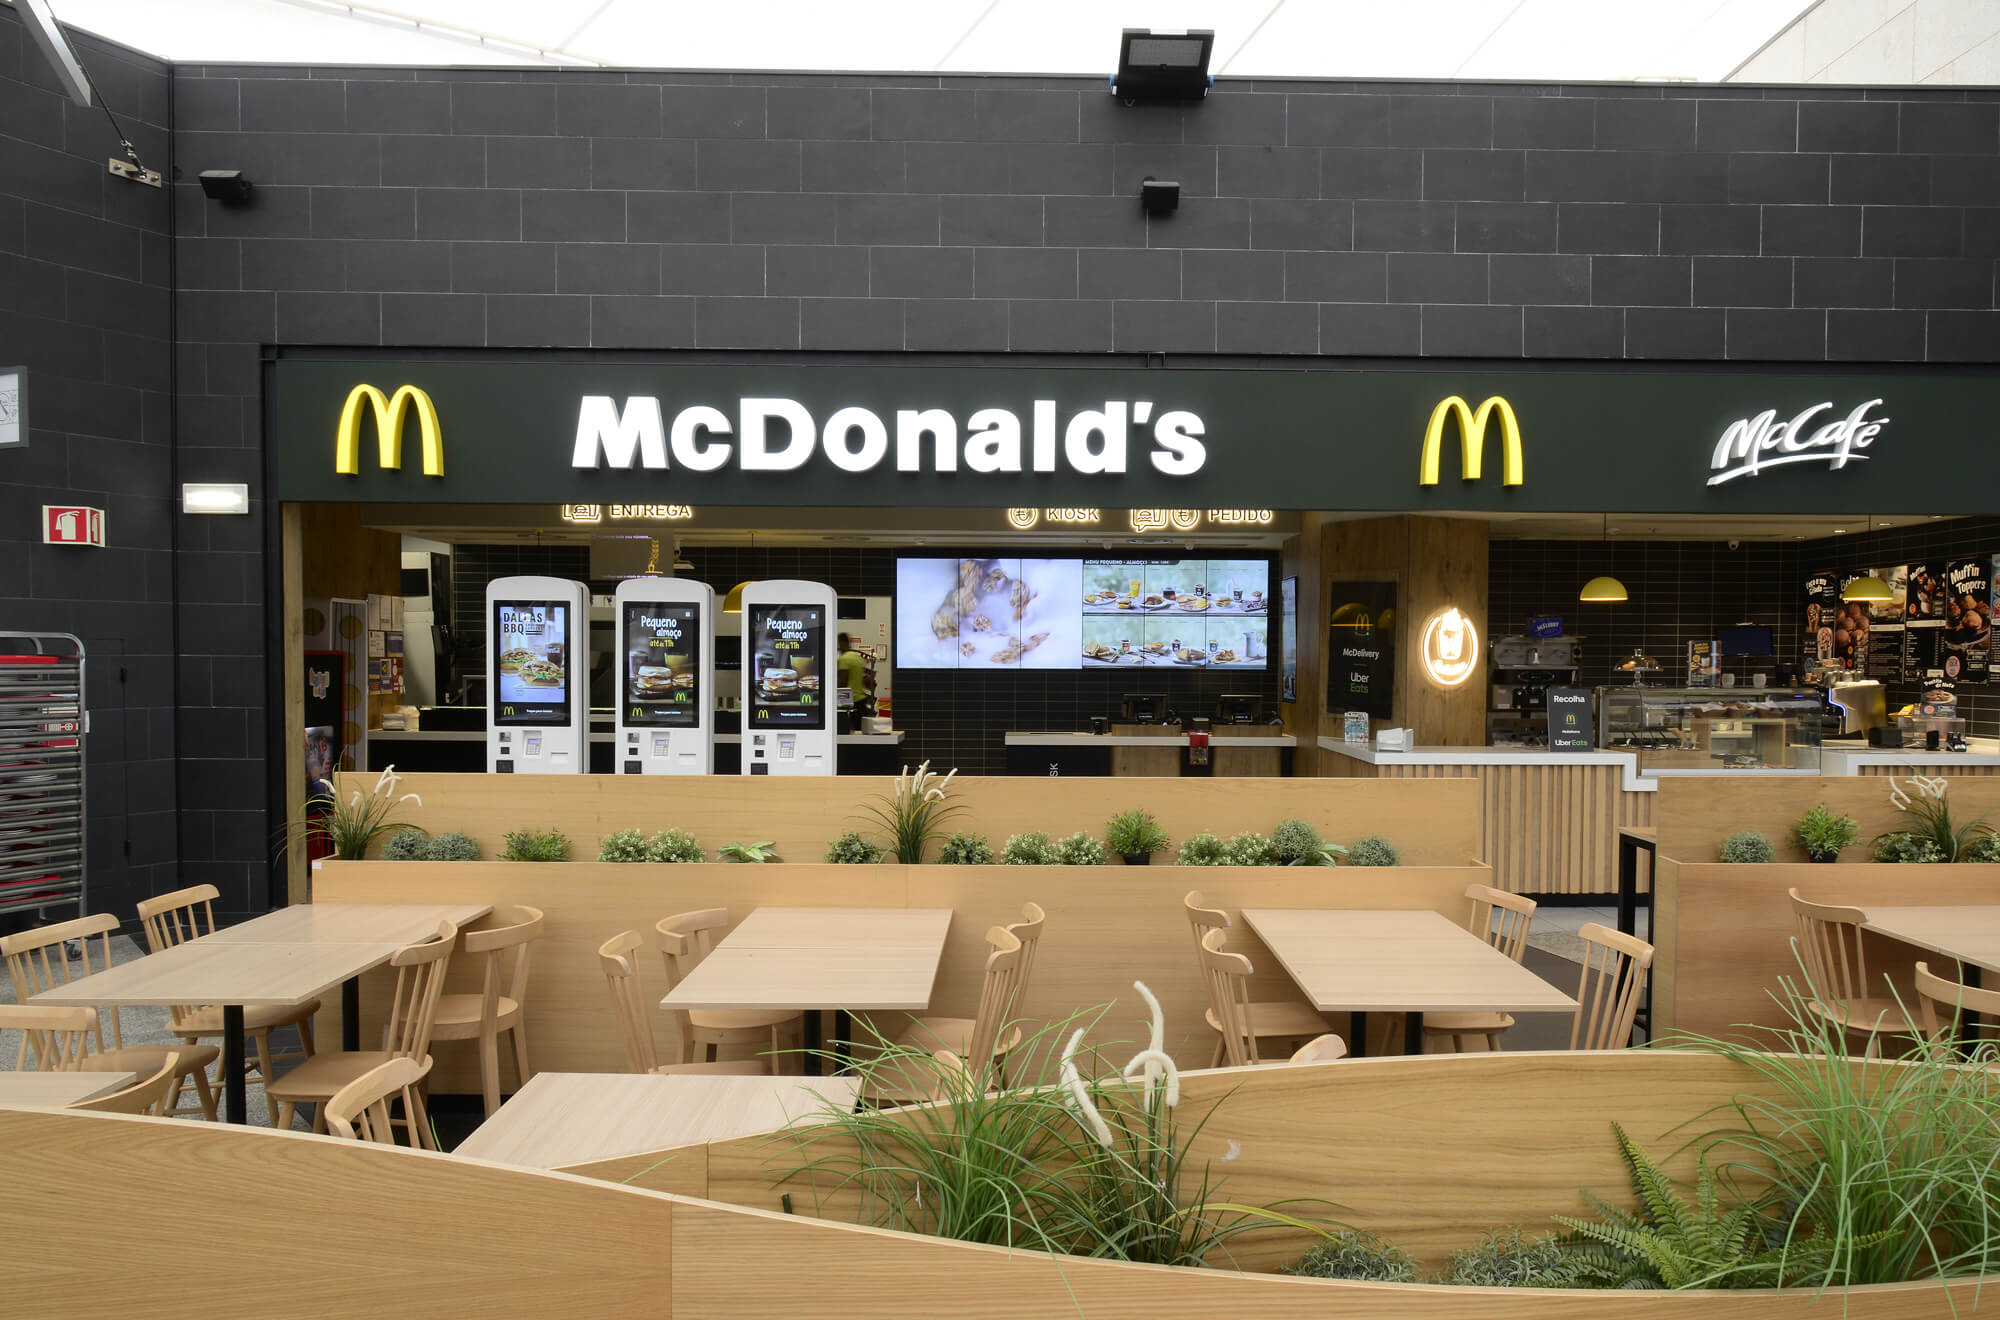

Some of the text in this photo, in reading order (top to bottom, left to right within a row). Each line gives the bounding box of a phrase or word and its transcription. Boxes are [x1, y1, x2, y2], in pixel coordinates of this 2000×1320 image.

[571, 394, 1207, 476] McDonald's
[1708, 398, 1891, 480] McCafé
[611, 505, 692, 518] ENTREGA
[1047, 508, 1099, 522] KIOSK
[1209, 509, 1272, 522] PEDIDO
[1950, 563, 1980, 585] Muffin
[1955, 580, 1987, 595] Toppers
[504, 623, 525, 635] BBQ
[641, 615, 677, 631] Pequeno
[766, 617, 803, 633] Pequeno
[656, 628, 682, 640] almoço
[782, 630, 808, 642] almoço
[1342, 648, 1380, 661] McDelivery
[1350, 671, 1369, 683] Uber
[1350, 683, 1369, 694] Eats
[1553, 695, 1586, 703] Recolha
[1049, 763, 1059, 777] SK
